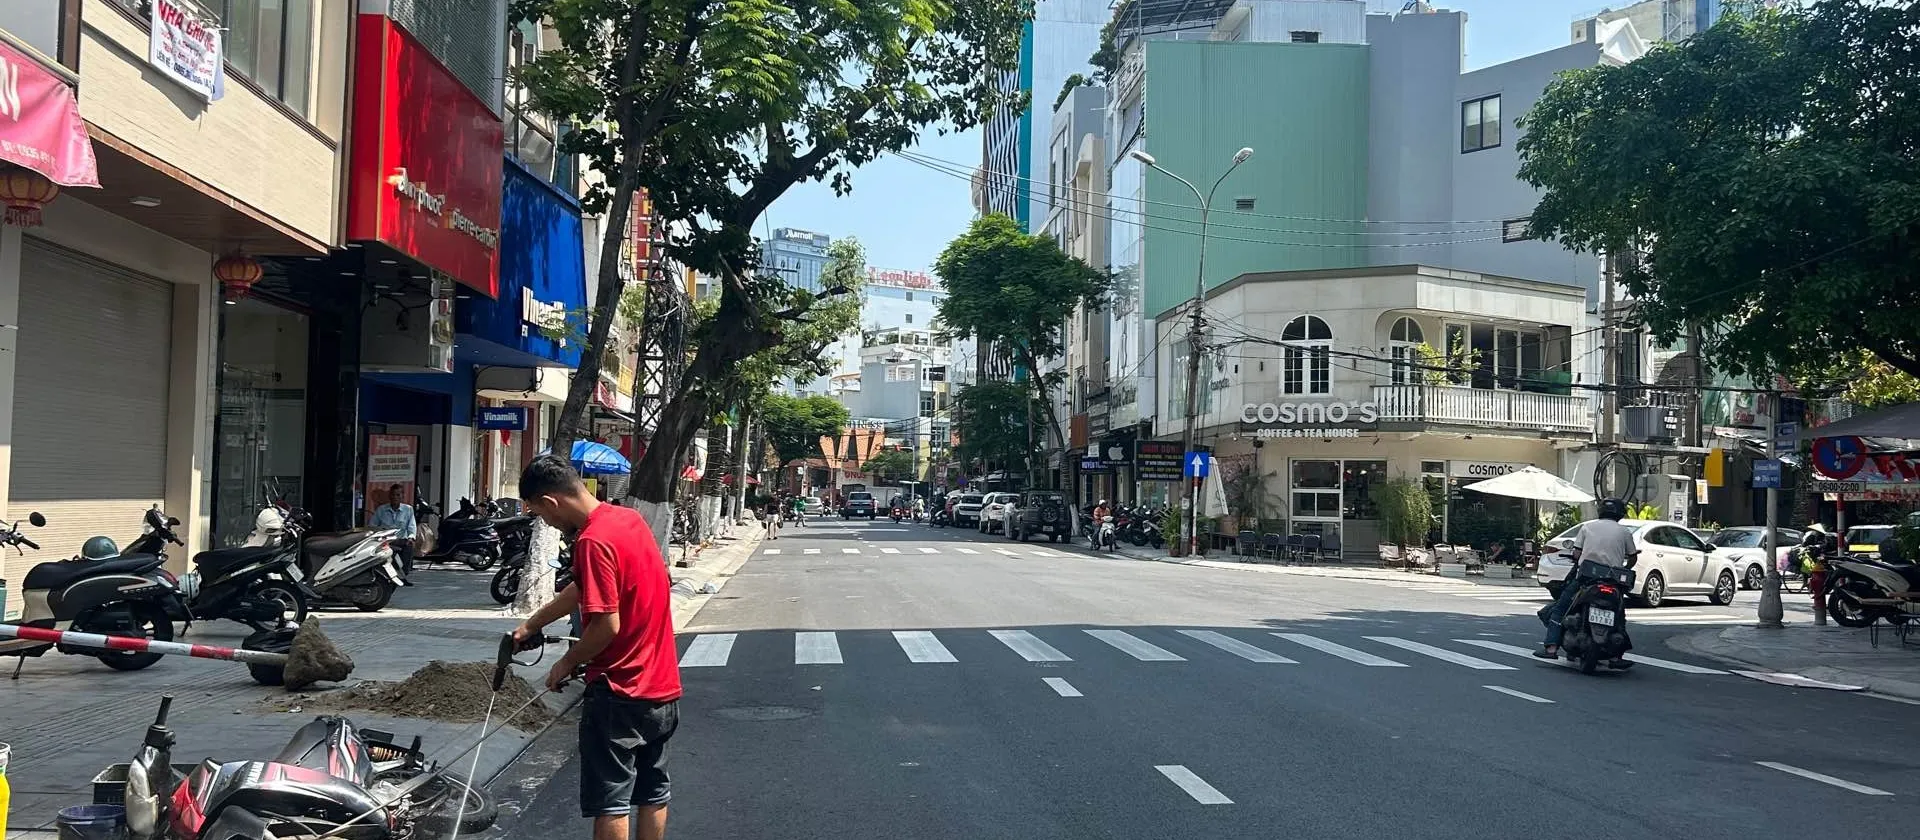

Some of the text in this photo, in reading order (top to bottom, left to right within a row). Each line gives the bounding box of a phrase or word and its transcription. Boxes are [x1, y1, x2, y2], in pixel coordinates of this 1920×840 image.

[483, 412, 518, 421] Vinamilk
[1257, 428, 1360, 438] COFFEE & TEA HOUSE
